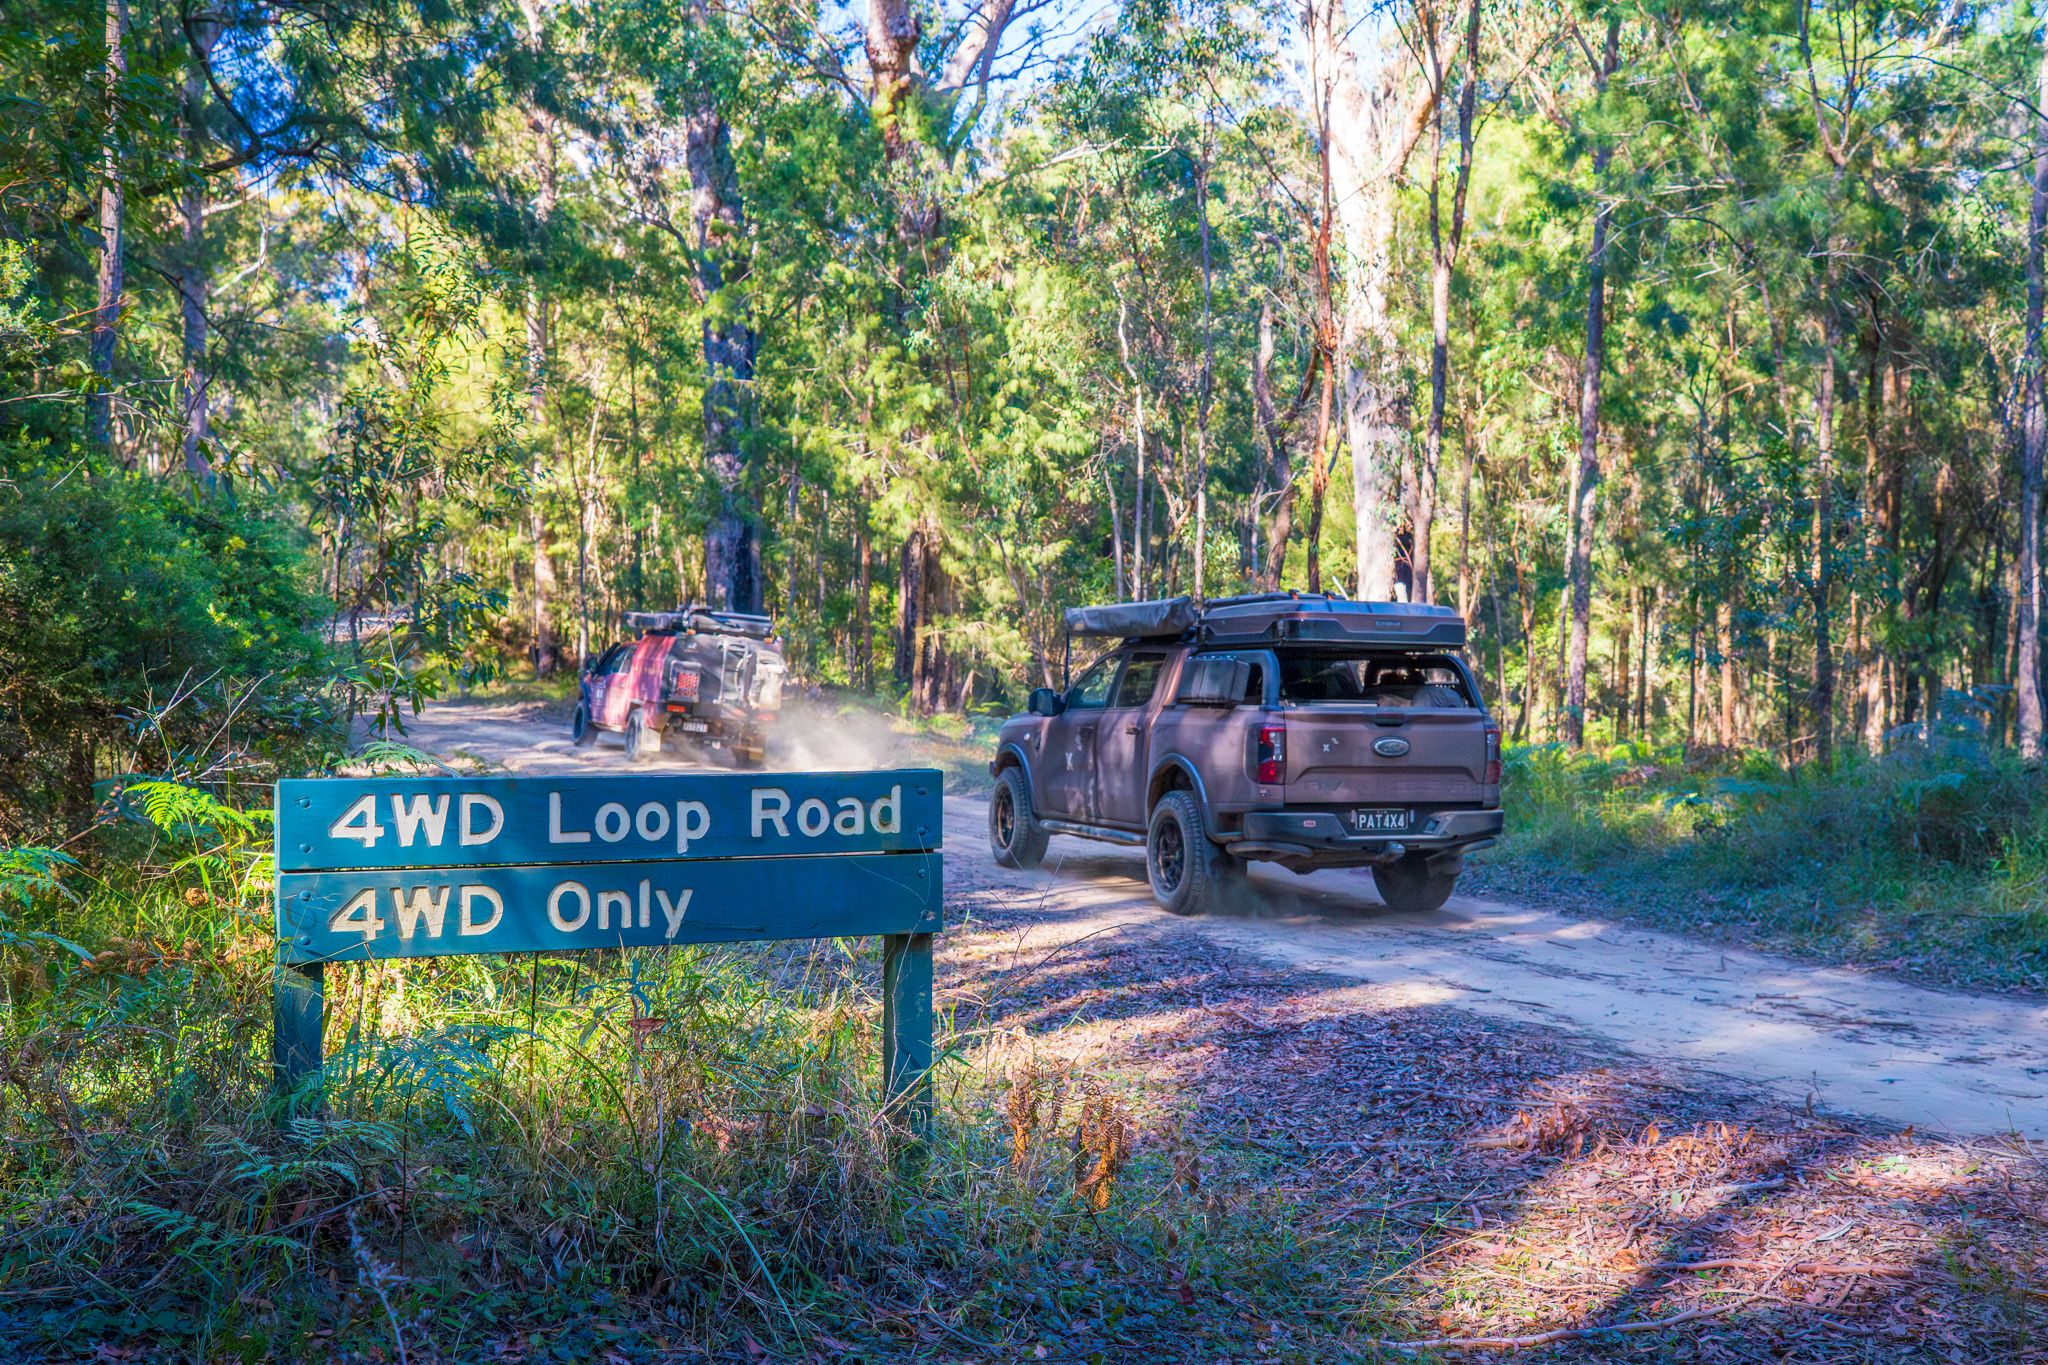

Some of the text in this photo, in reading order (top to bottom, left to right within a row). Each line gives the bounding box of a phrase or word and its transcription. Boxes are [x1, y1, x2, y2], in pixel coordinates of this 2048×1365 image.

[329, 783, 902, 854] 4WD Loop Road
[1358, 814, 1405, 829] PAT4X4
[329, 877, 695, 941] 4WD Only
